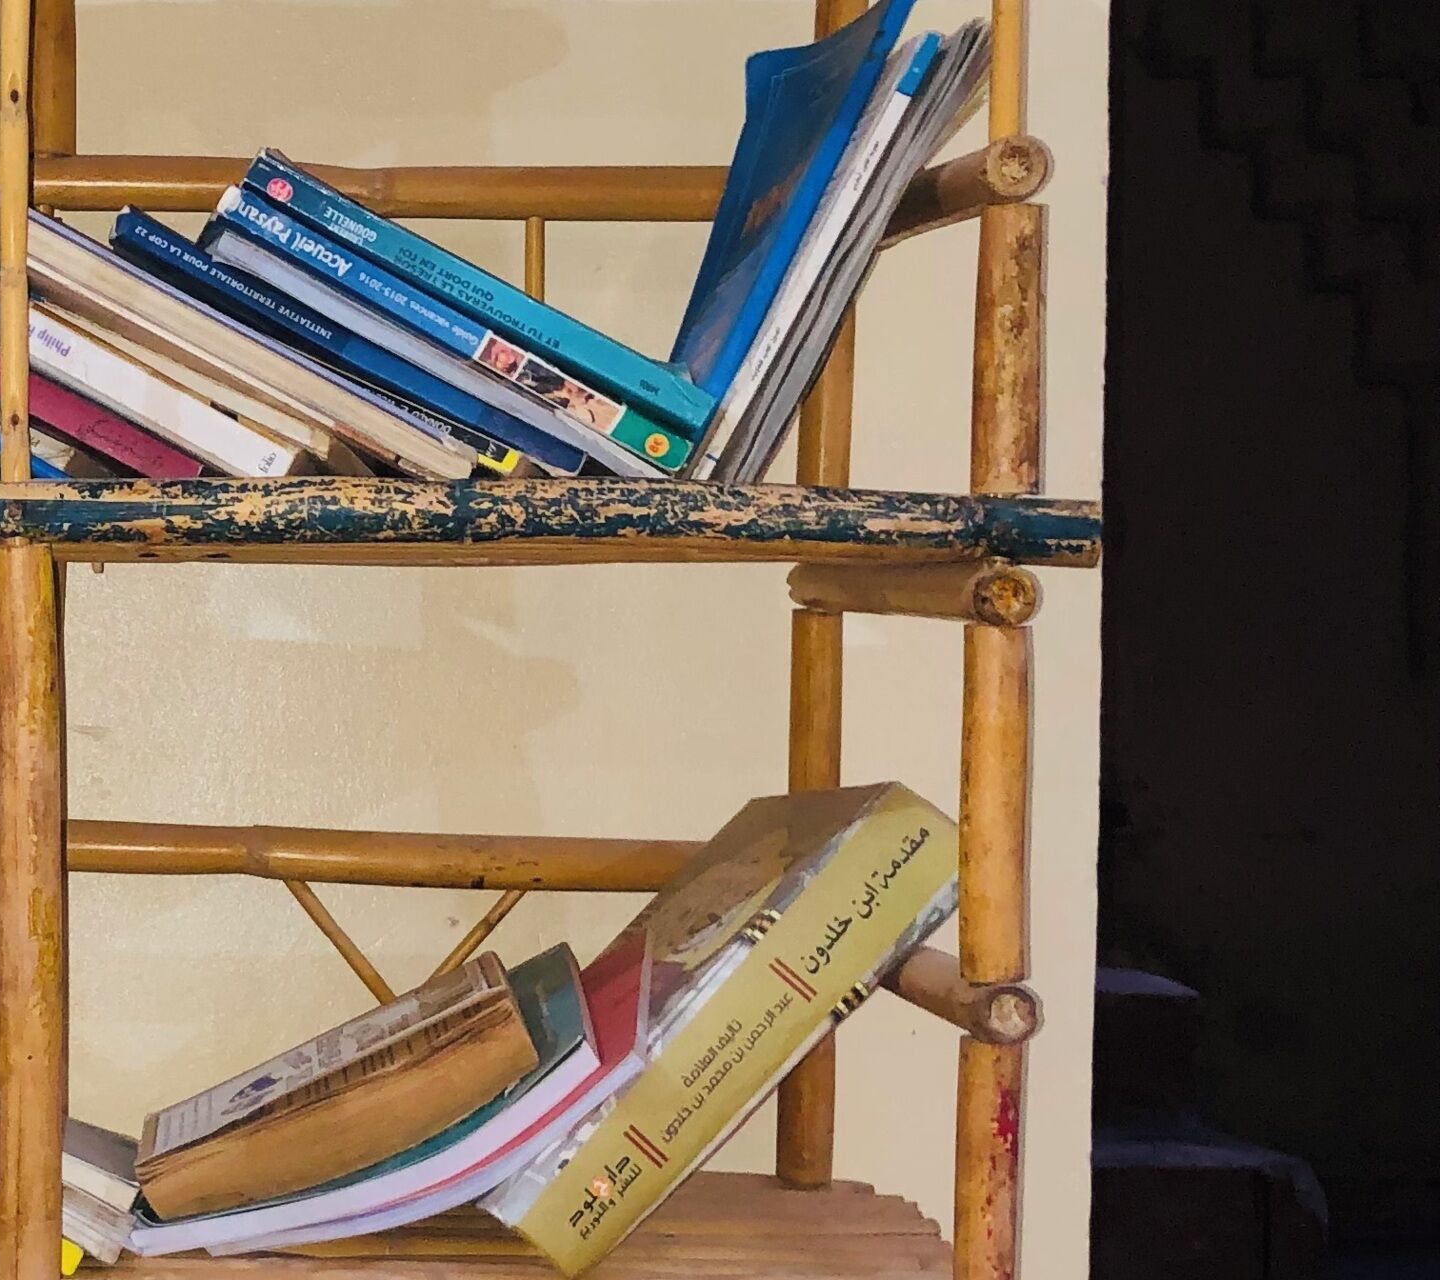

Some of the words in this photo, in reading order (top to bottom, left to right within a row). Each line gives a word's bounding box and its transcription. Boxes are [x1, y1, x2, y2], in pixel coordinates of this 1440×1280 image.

[133, 224, 148, 237] 22
[231, 196, 294, 243] Paysan
[322, 205, 378, 243] GOUNELLE
[147, 232, 169, 249] COP
[167, 243, 182, 256] LA
[397, 244, 420, 262] TOI
[181, 251, 209, 271] POUR
[289, 231, 353, 279] Accueil
[417, 255, 437, 272] EN
[208, 266, 277, 309] TERRITORIALE
[357, 270, 408, 305] 2015-2016
[435, 277, 455, 293] LE
[436, 265, 472, 290] DORT
[469, 282, 495, 303] QUI
[277, 304, 332, 340] INITIATIVE
[406, 298, 452, 330] vacances
[454, 286, 531, 334] TROUVERAS
[34, 327, 72, 357] Philip
[449, 322, 480, 346] Guide
[528, 326, 544, 340] TU
[542, 333, 560, 349] ET
[256, 452, 277, 474] folio
[869, 821, 933, 890] مقدمة
[846, 881, 885, 921] ابن
[795, 908, 861, 977] خلدون
[771, 990, 795, 1014] عبد
[740, 1009, 779, 1051] الرحمن
[678, 1044, 720, 1090] العلامة
[728, 1045, 748, 1065] بن
[700, 1058, 735, 1096] محمد
[687, 1091, 707, 1111] بن
[658, 1105, 695, 1145] خلدون
